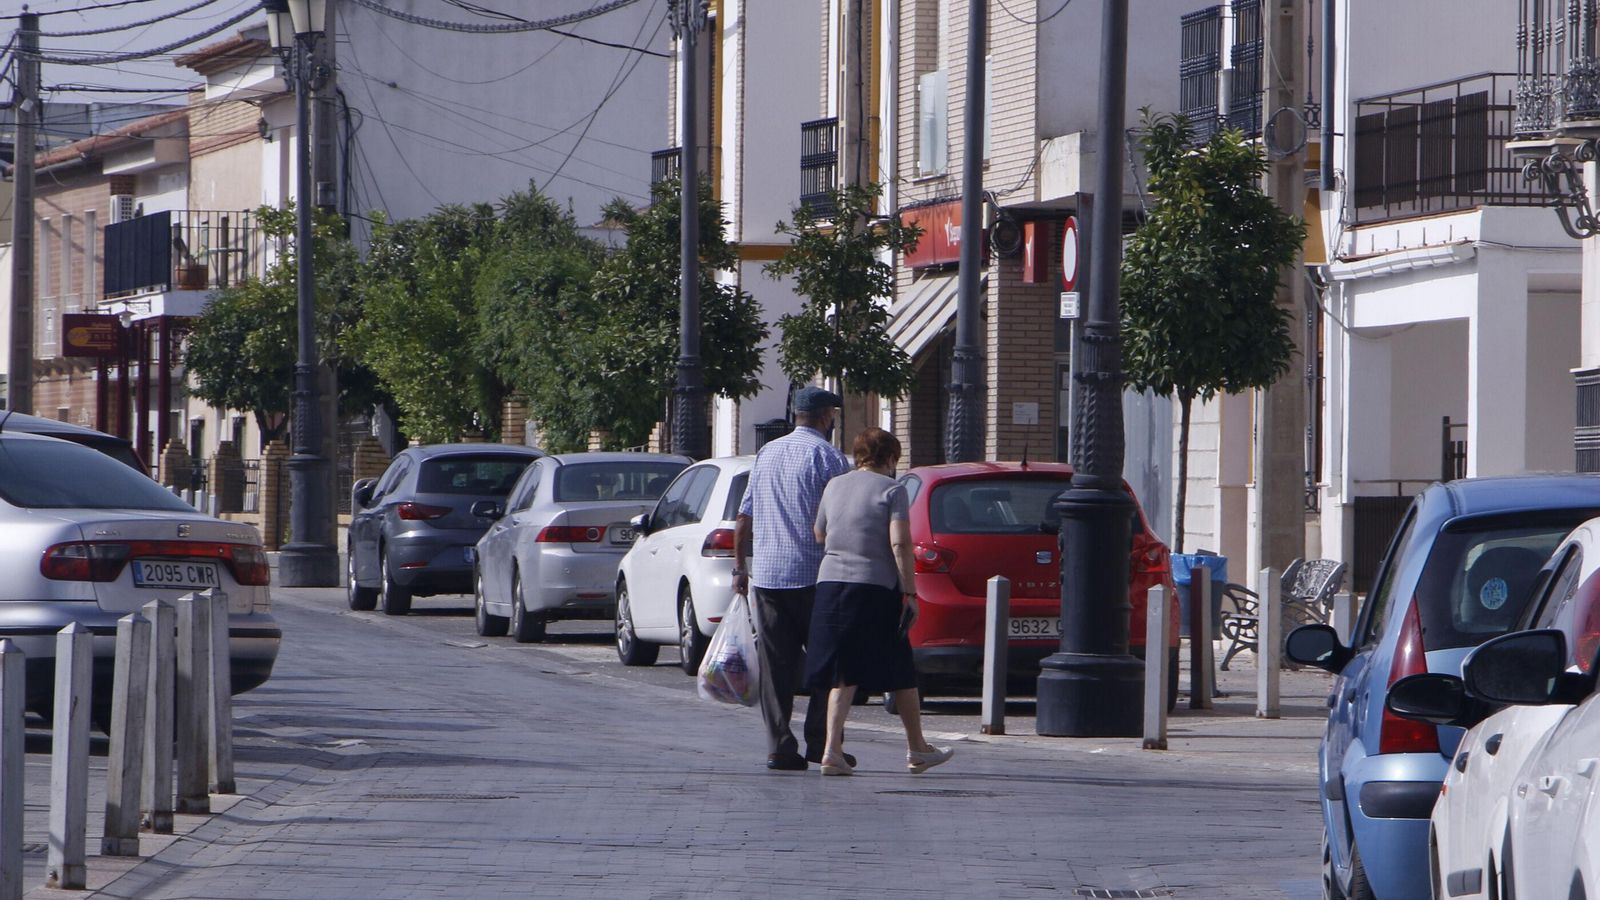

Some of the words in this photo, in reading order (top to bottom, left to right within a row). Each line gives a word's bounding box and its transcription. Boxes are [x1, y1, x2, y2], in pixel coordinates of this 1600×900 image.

[620, 529, 636, 541] 90
[144, 564, 183, 583] 2095
[187, 566, 215, 585] CWR
[1011, 620, 1050, 634] 9632
